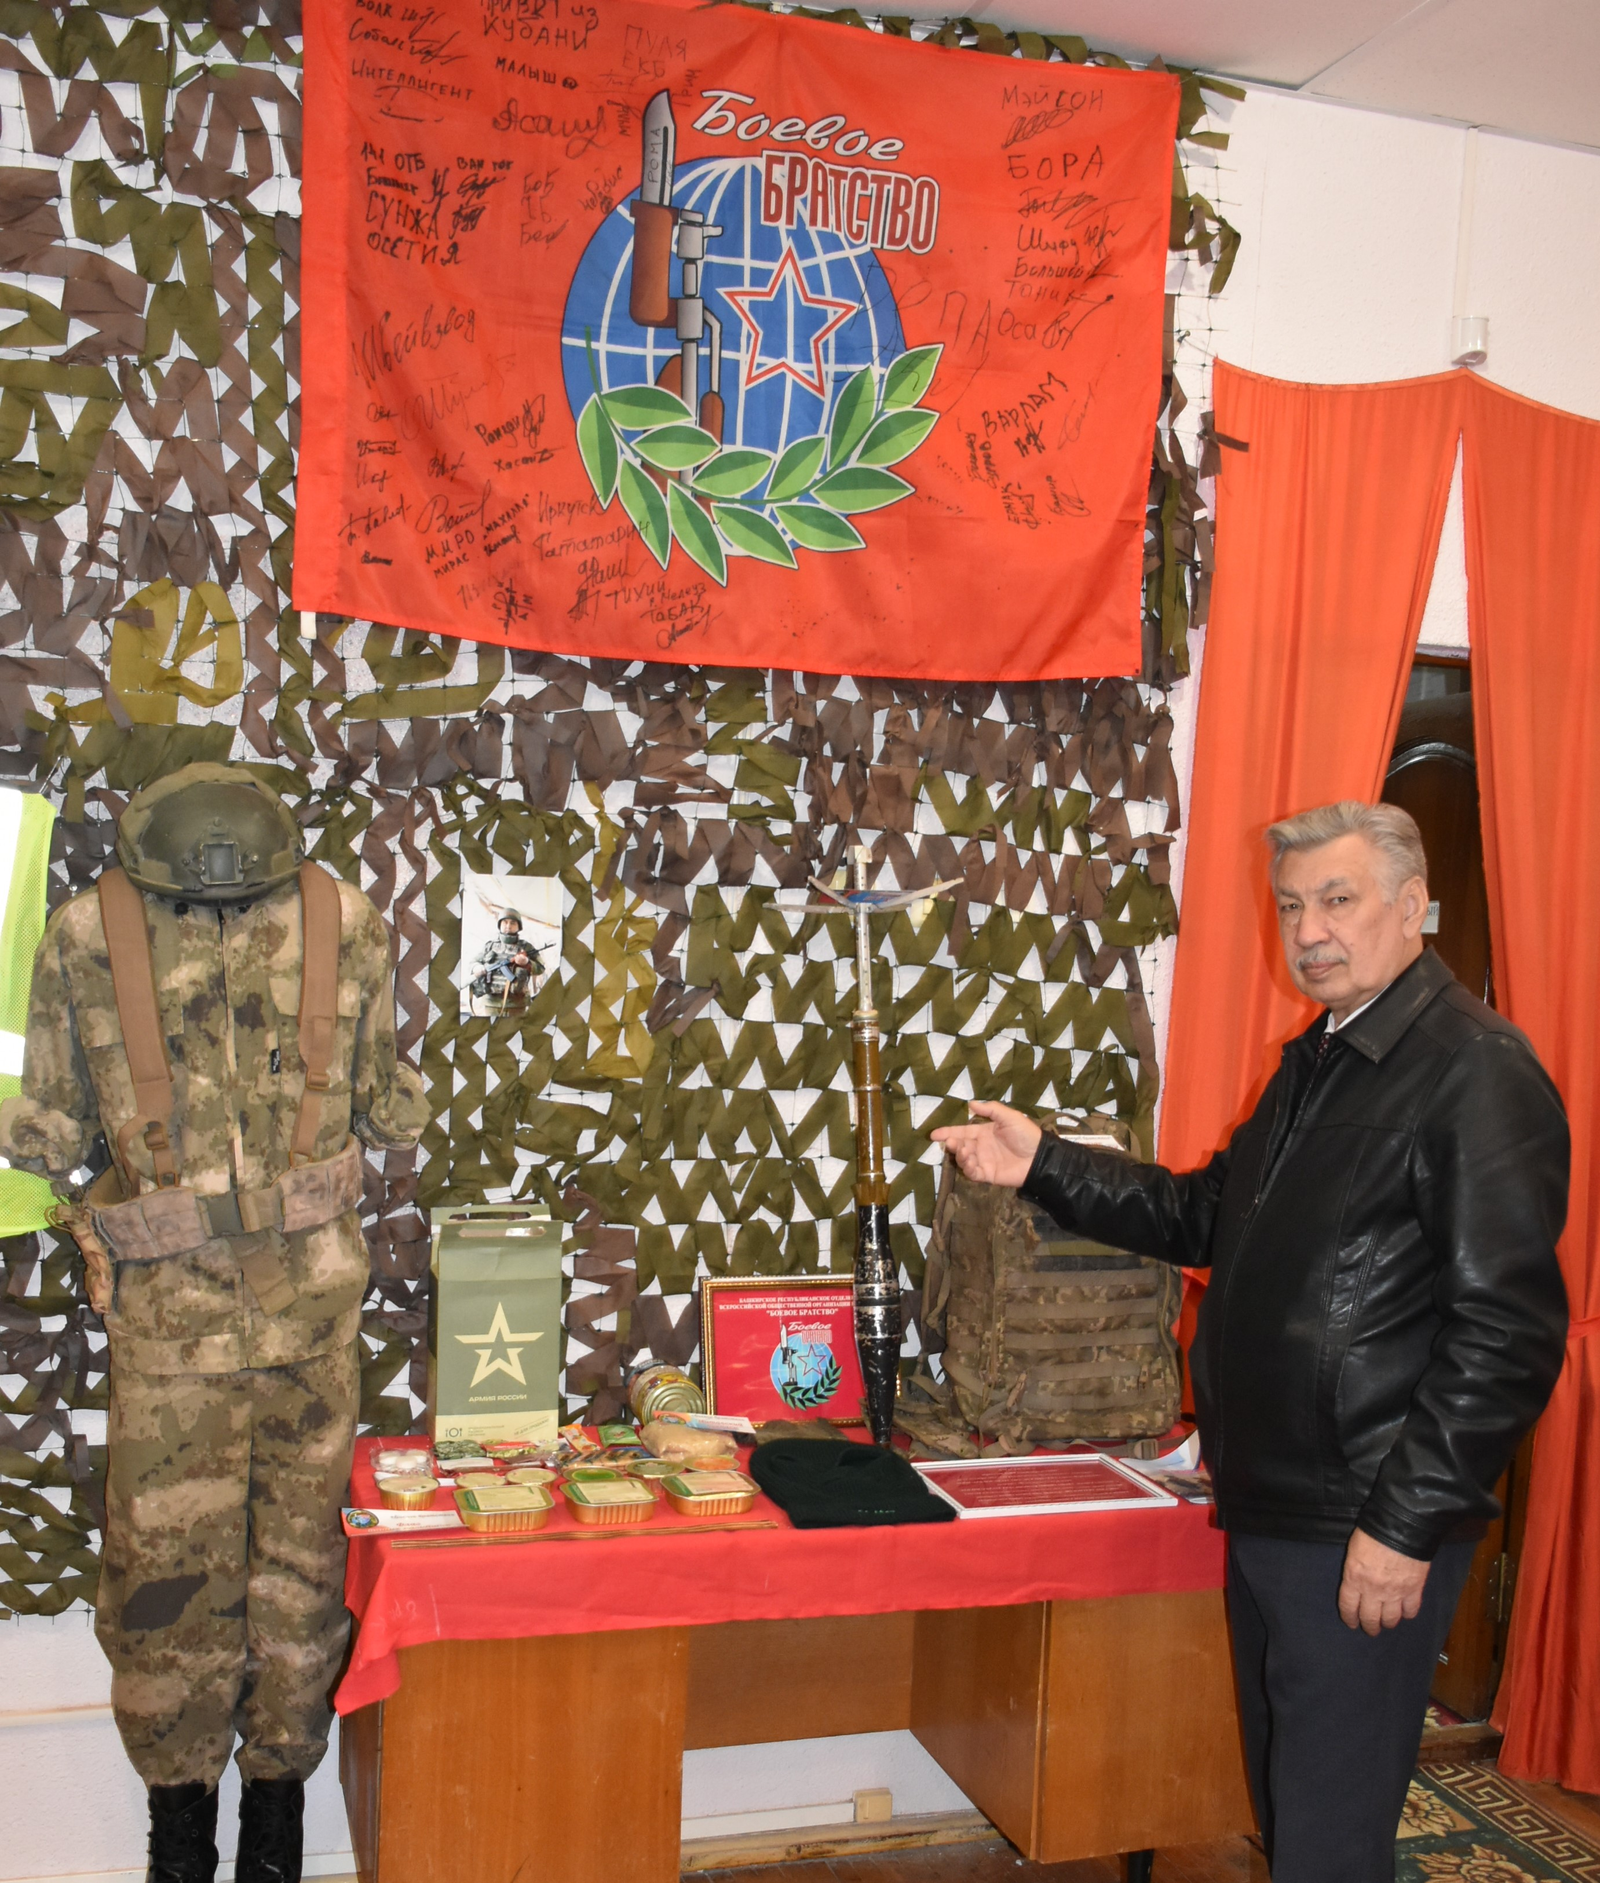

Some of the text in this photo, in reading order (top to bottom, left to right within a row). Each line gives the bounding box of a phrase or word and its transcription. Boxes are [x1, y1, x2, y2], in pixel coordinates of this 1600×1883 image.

[496, 57, 556, 84] МАЛЫШ
[692, 89, 905, 161] Боевое
[647, 127, 662, 184] РОМА
[1007, 144, 1104, 181] БОРА
[761, 150, 940, 255] БРАТСТВО
[367, 232, 465, 266] ОСЕТИЯ
[788, 1321, 832, 1331] Боевое
[799, 1308, 839, 1316] БРАТСТВО"
